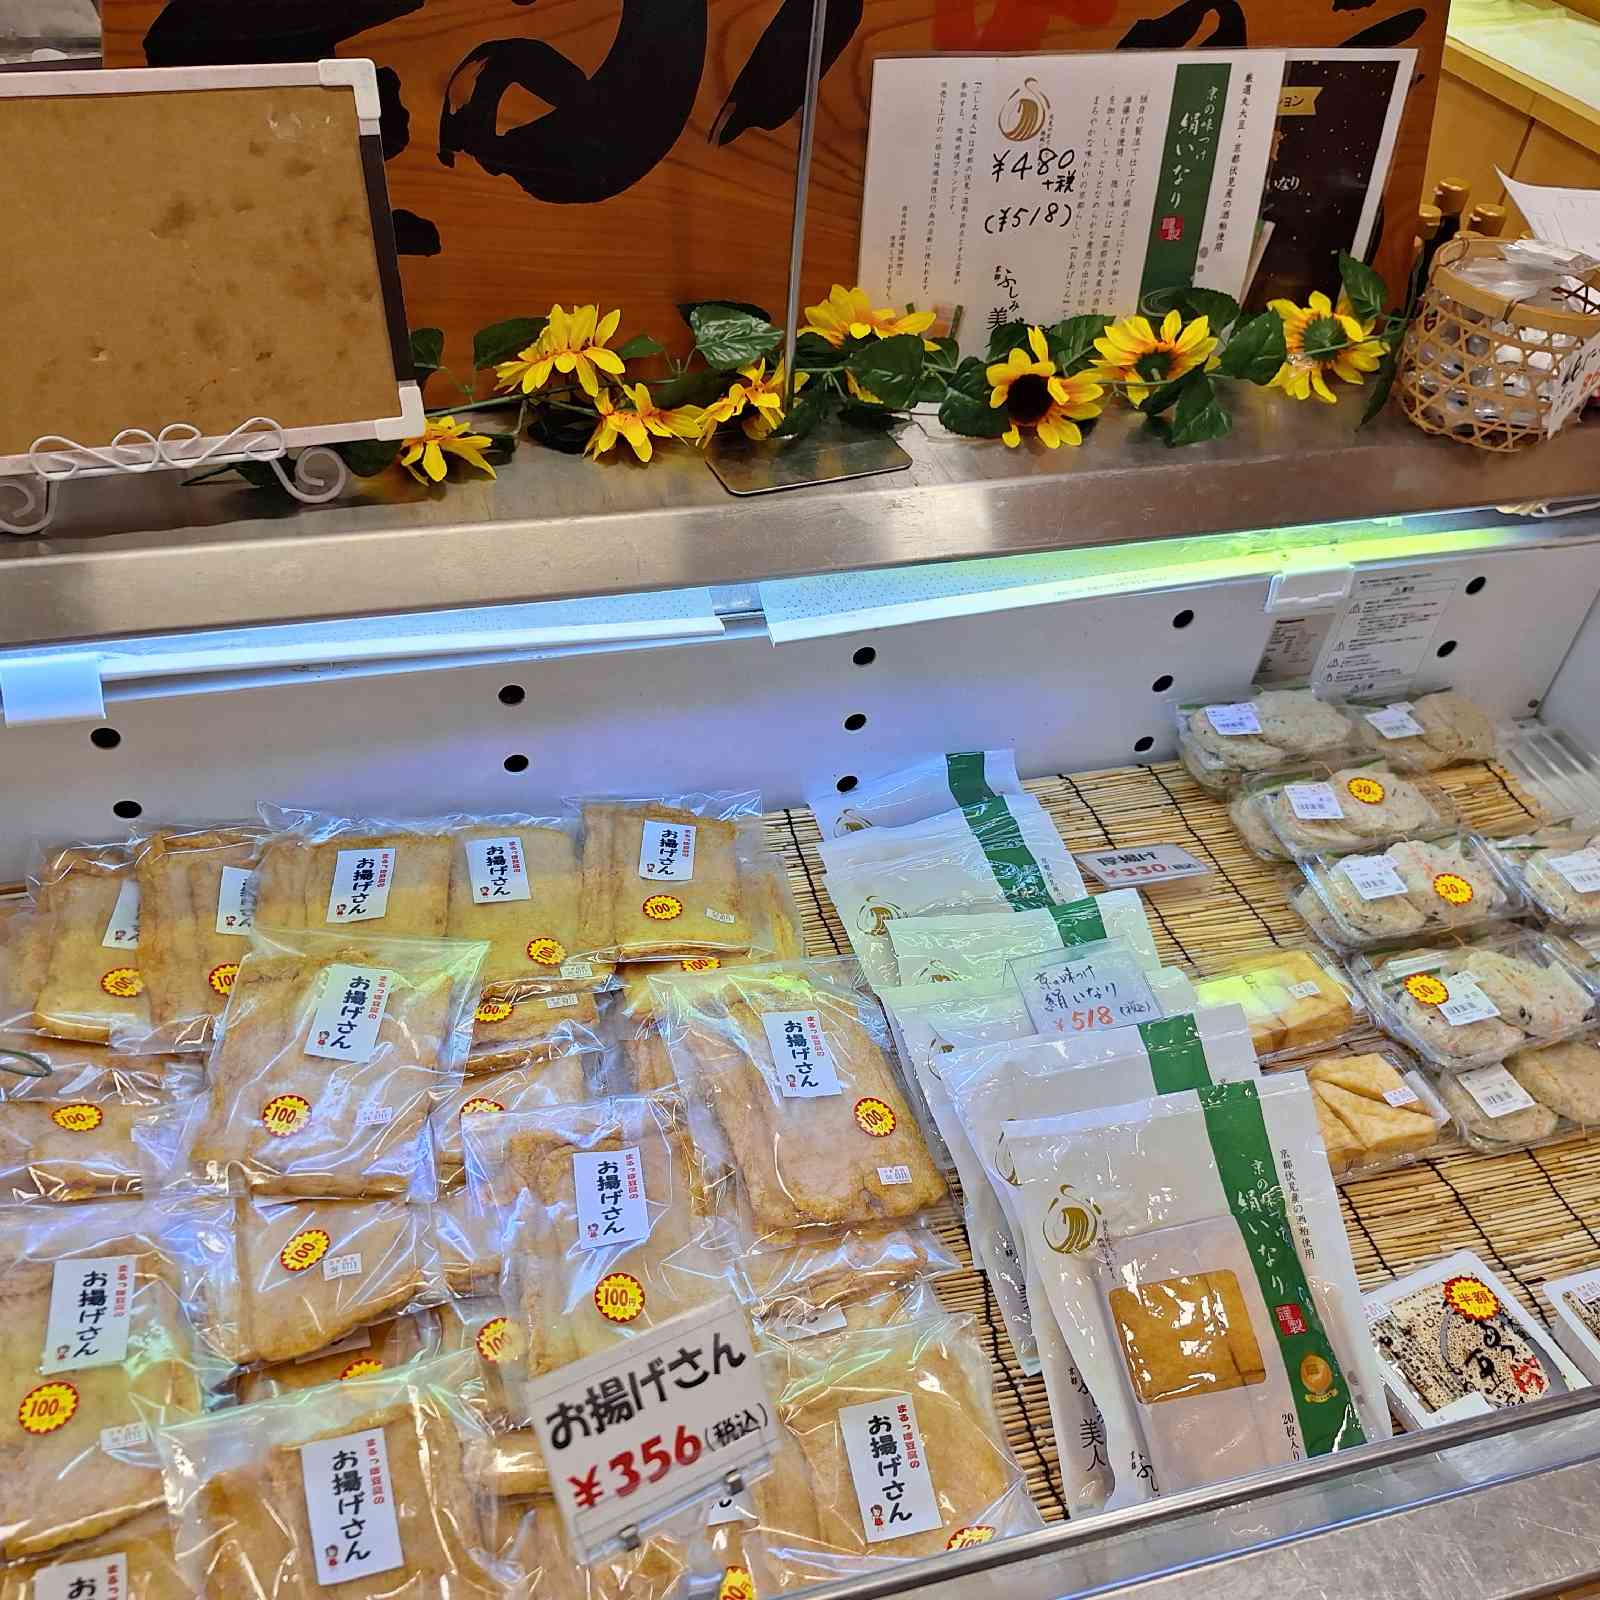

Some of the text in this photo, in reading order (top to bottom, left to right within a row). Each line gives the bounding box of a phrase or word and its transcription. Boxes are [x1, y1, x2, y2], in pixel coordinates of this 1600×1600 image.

[991, 148, 1075, 183] ¥480
[1170, 112, 1200, 209] 絹いなり
[984, 202, 1072, 235] (¥518)
[348, 857, 375, 915] お揚げさん
[486, 846, 511, 896] お揚げさん
[658, 829, 680, 876] お揚げさん
[331, 976, 371, 1050] お揚げさん
[1055, 1006, 1115, 1032] ¥518
[784, 1020, 819, 1088] お揚げさん
[597, 1161, 624, 1236] お揚げさん
[1238, 1189, 1284, 1297] 絹いなり
[73, 1270, 108, 1359] お揚げさん
[546, 1332, 746, 1450] お揚げさん
[568, 1402, 769, 1509] ¥356 (税込)
[868, 1415, 912, 1524] お揚げさん
[1080, 1418, 1106, 1472] 美人
[1282, 1412, 1300, 1462] 20枚入り
[332, 1450, 371, 1564] お揚げさん
